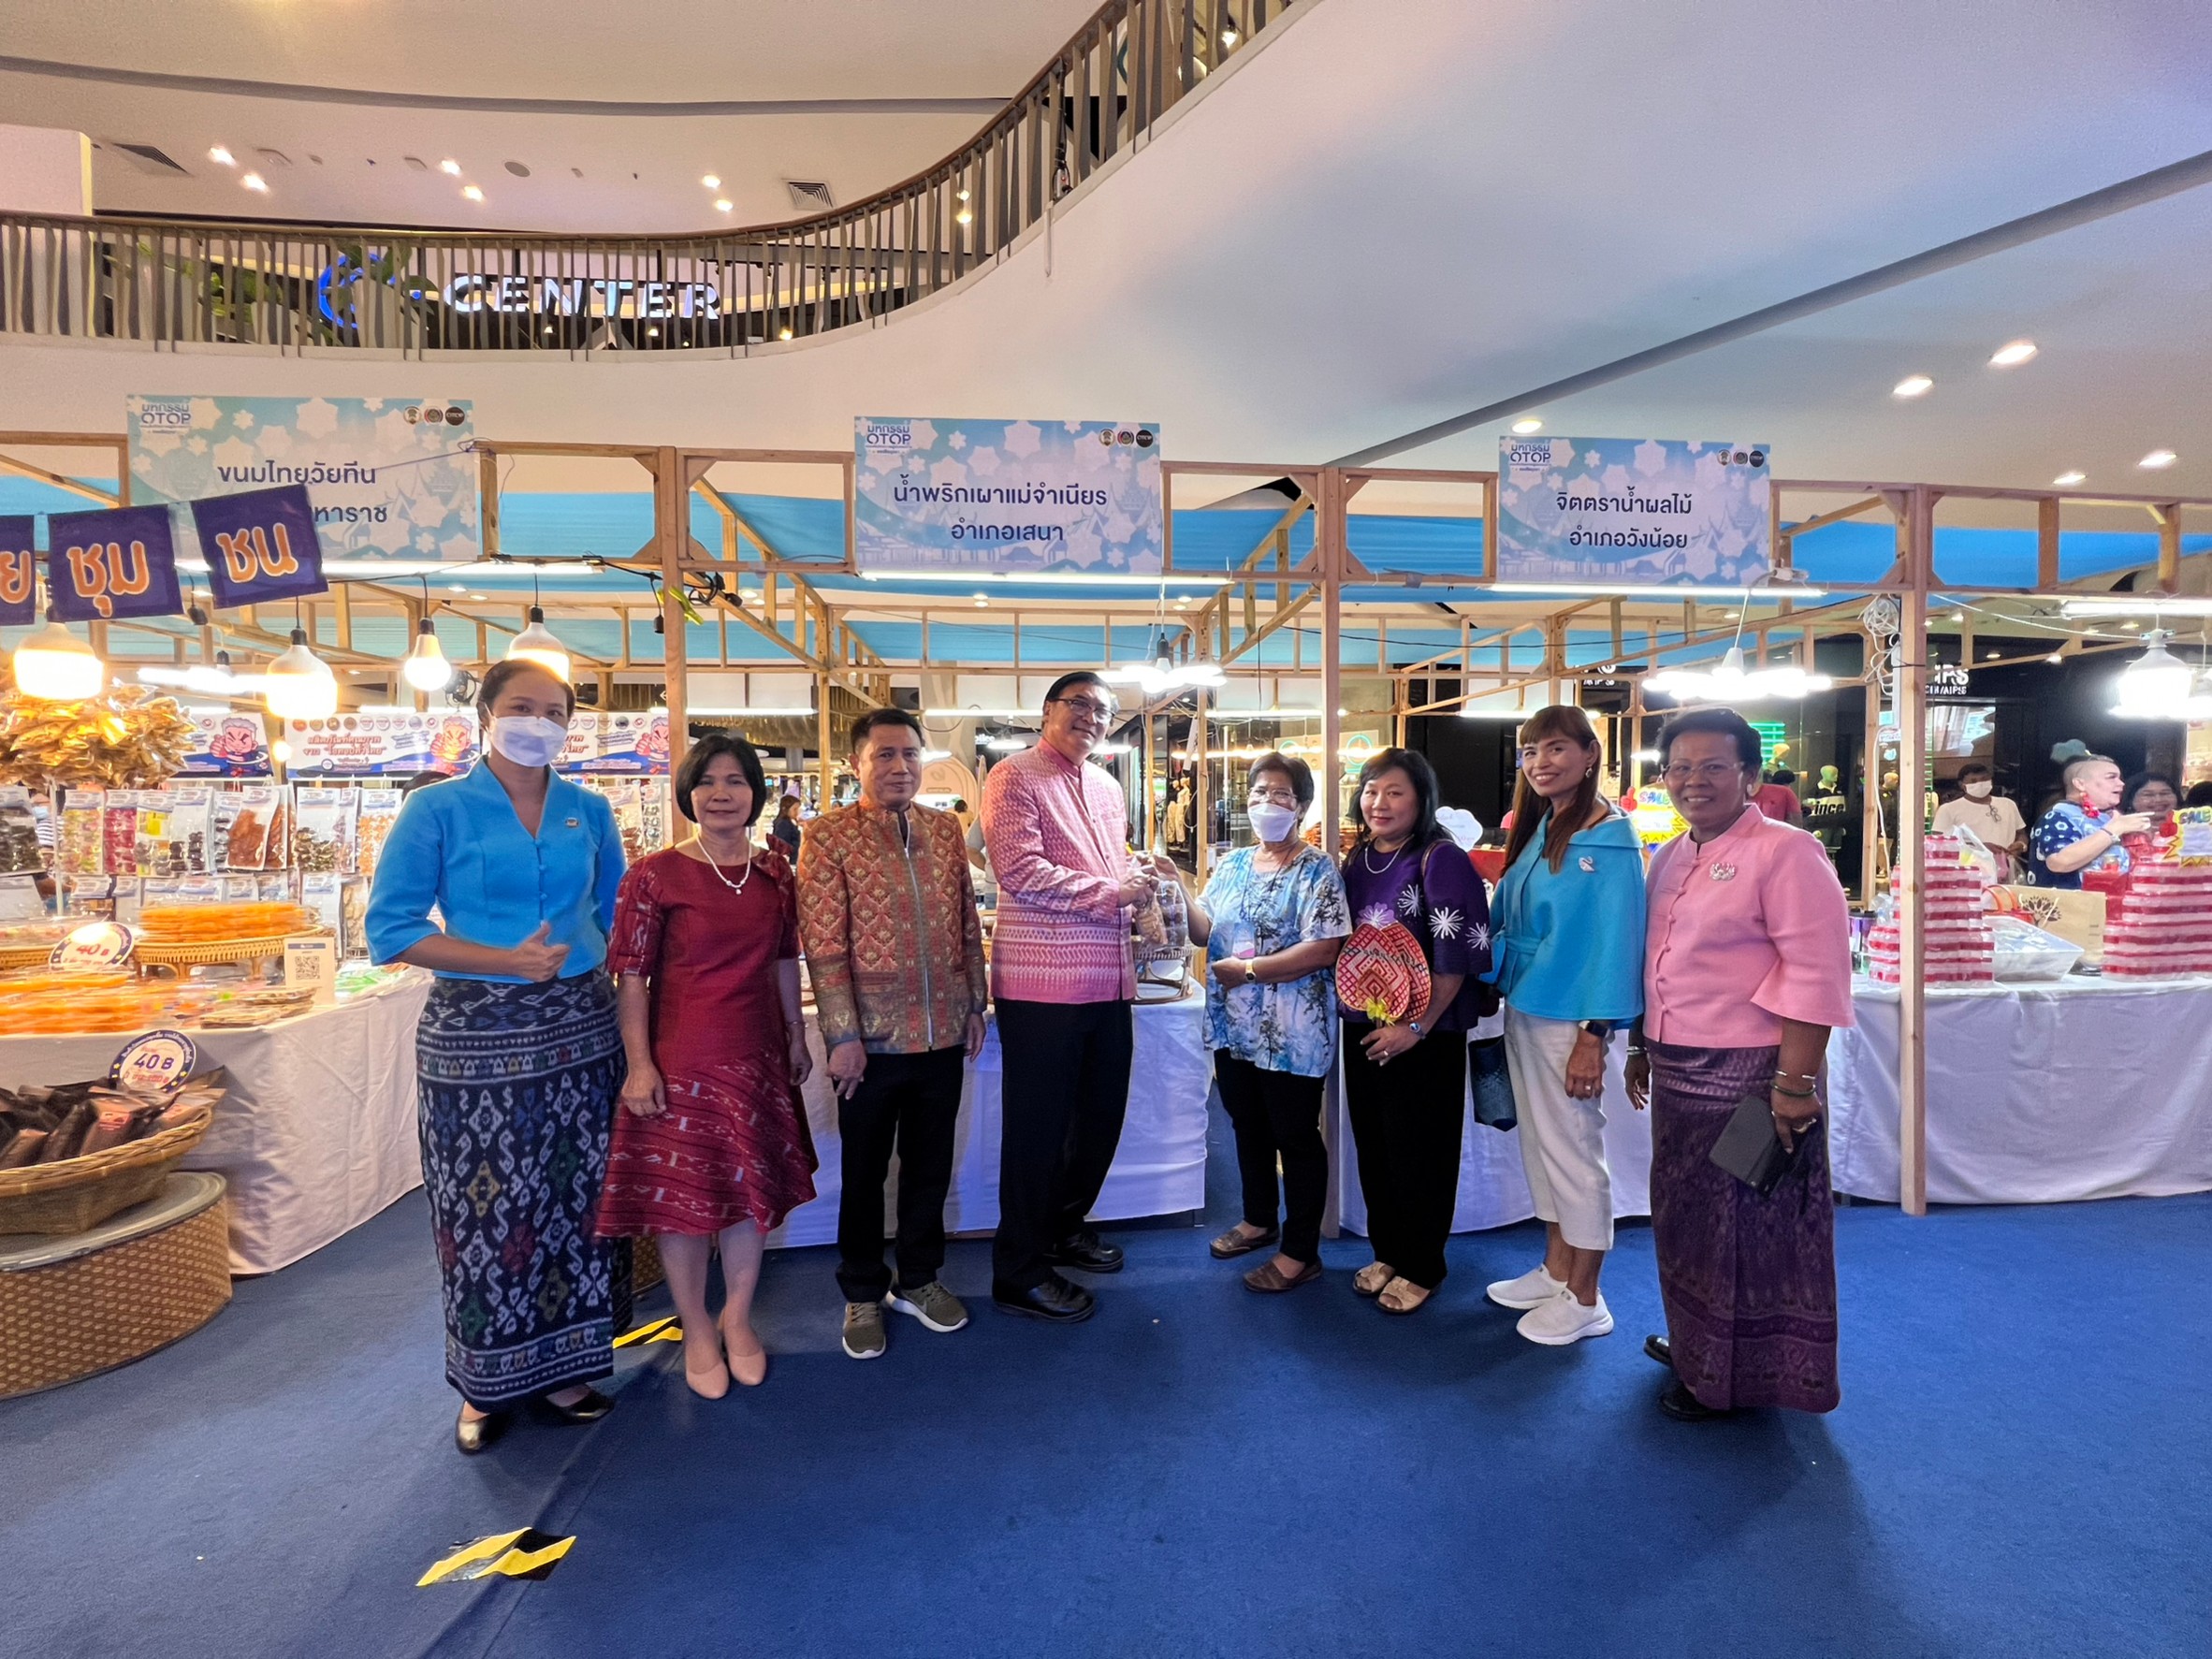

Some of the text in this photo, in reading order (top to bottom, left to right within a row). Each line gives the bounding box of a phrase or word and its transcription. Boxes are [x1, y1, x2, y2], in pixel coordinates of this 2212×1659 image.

[444, 275, 719, 320] CENTER
[140, 413, 192, 425] OTOP
[866, 432, 912, 445] OTOP
[1509, 451, 1551, 463] OTOP
[217, 459, 376, 485] ขนมไทยวัยทีน
[894, 473, 1108, 506] น้ำพริกเผาแม่จำเนียร
[1556, 486, 1692, 515] จิตตราน้ำผลไม้
[313, 506, 387, 523] หาราช
[951, 517, 1064, 541] อำเภอเสนา
[1569, 525, 1688, 549] อำเภอวังน้อย
[66, 540, 150, 618] ชุม
[215, 522, 298, 583] ชน
[134, 1053, 161, 1070] 40
